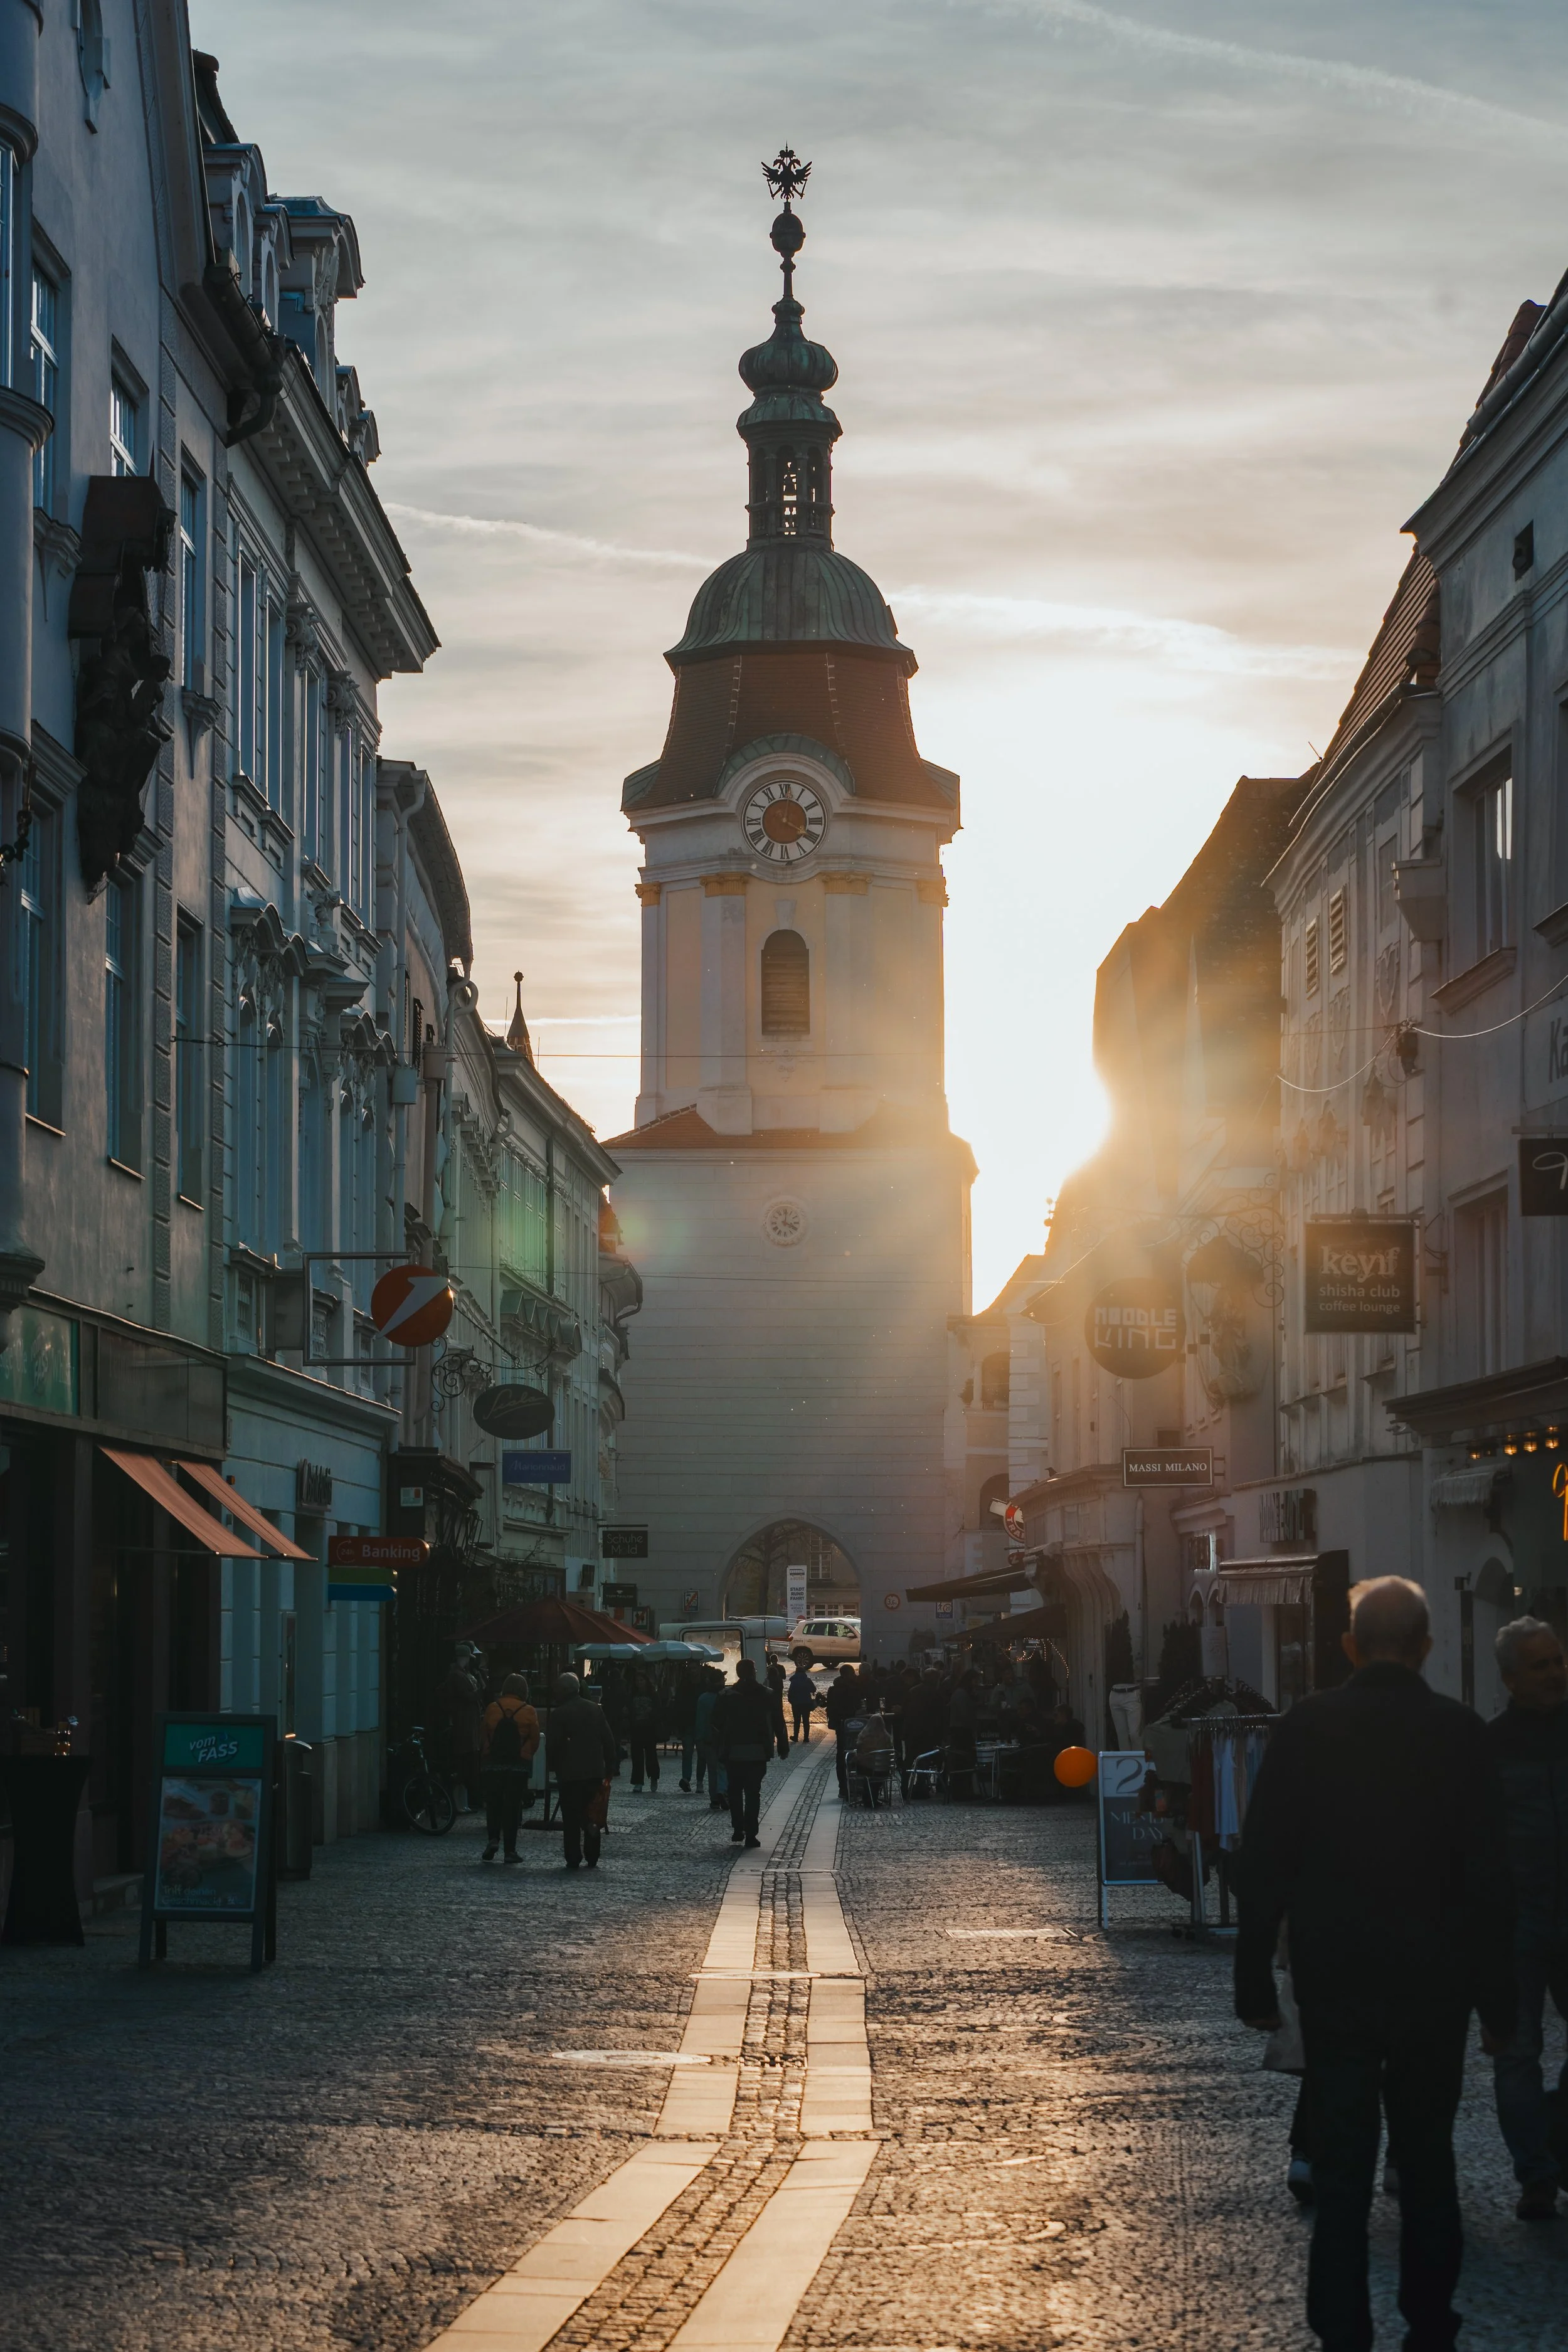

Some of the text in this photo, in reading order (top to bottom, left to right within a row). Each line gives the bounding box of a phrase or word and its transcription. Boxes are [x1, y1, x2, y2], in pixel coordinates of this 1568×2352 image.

[1319, 1283, 1401, 1298] shisha club
[1319, 1300, 1401, 1315] coffee lounge
[1094, 1306, 1177, 1326] NOODLE
[1094, 1328, 1177, 1349] KING
[1129, 1463, 1207, 1472] MASSI MILANO
[607, 1533, 644, 1544] Schuhe
[362, 1544, 421, 1562] Banking
[189, 1735, 216, 1751] vom
[198, 1741, 238, 1763] FASS
